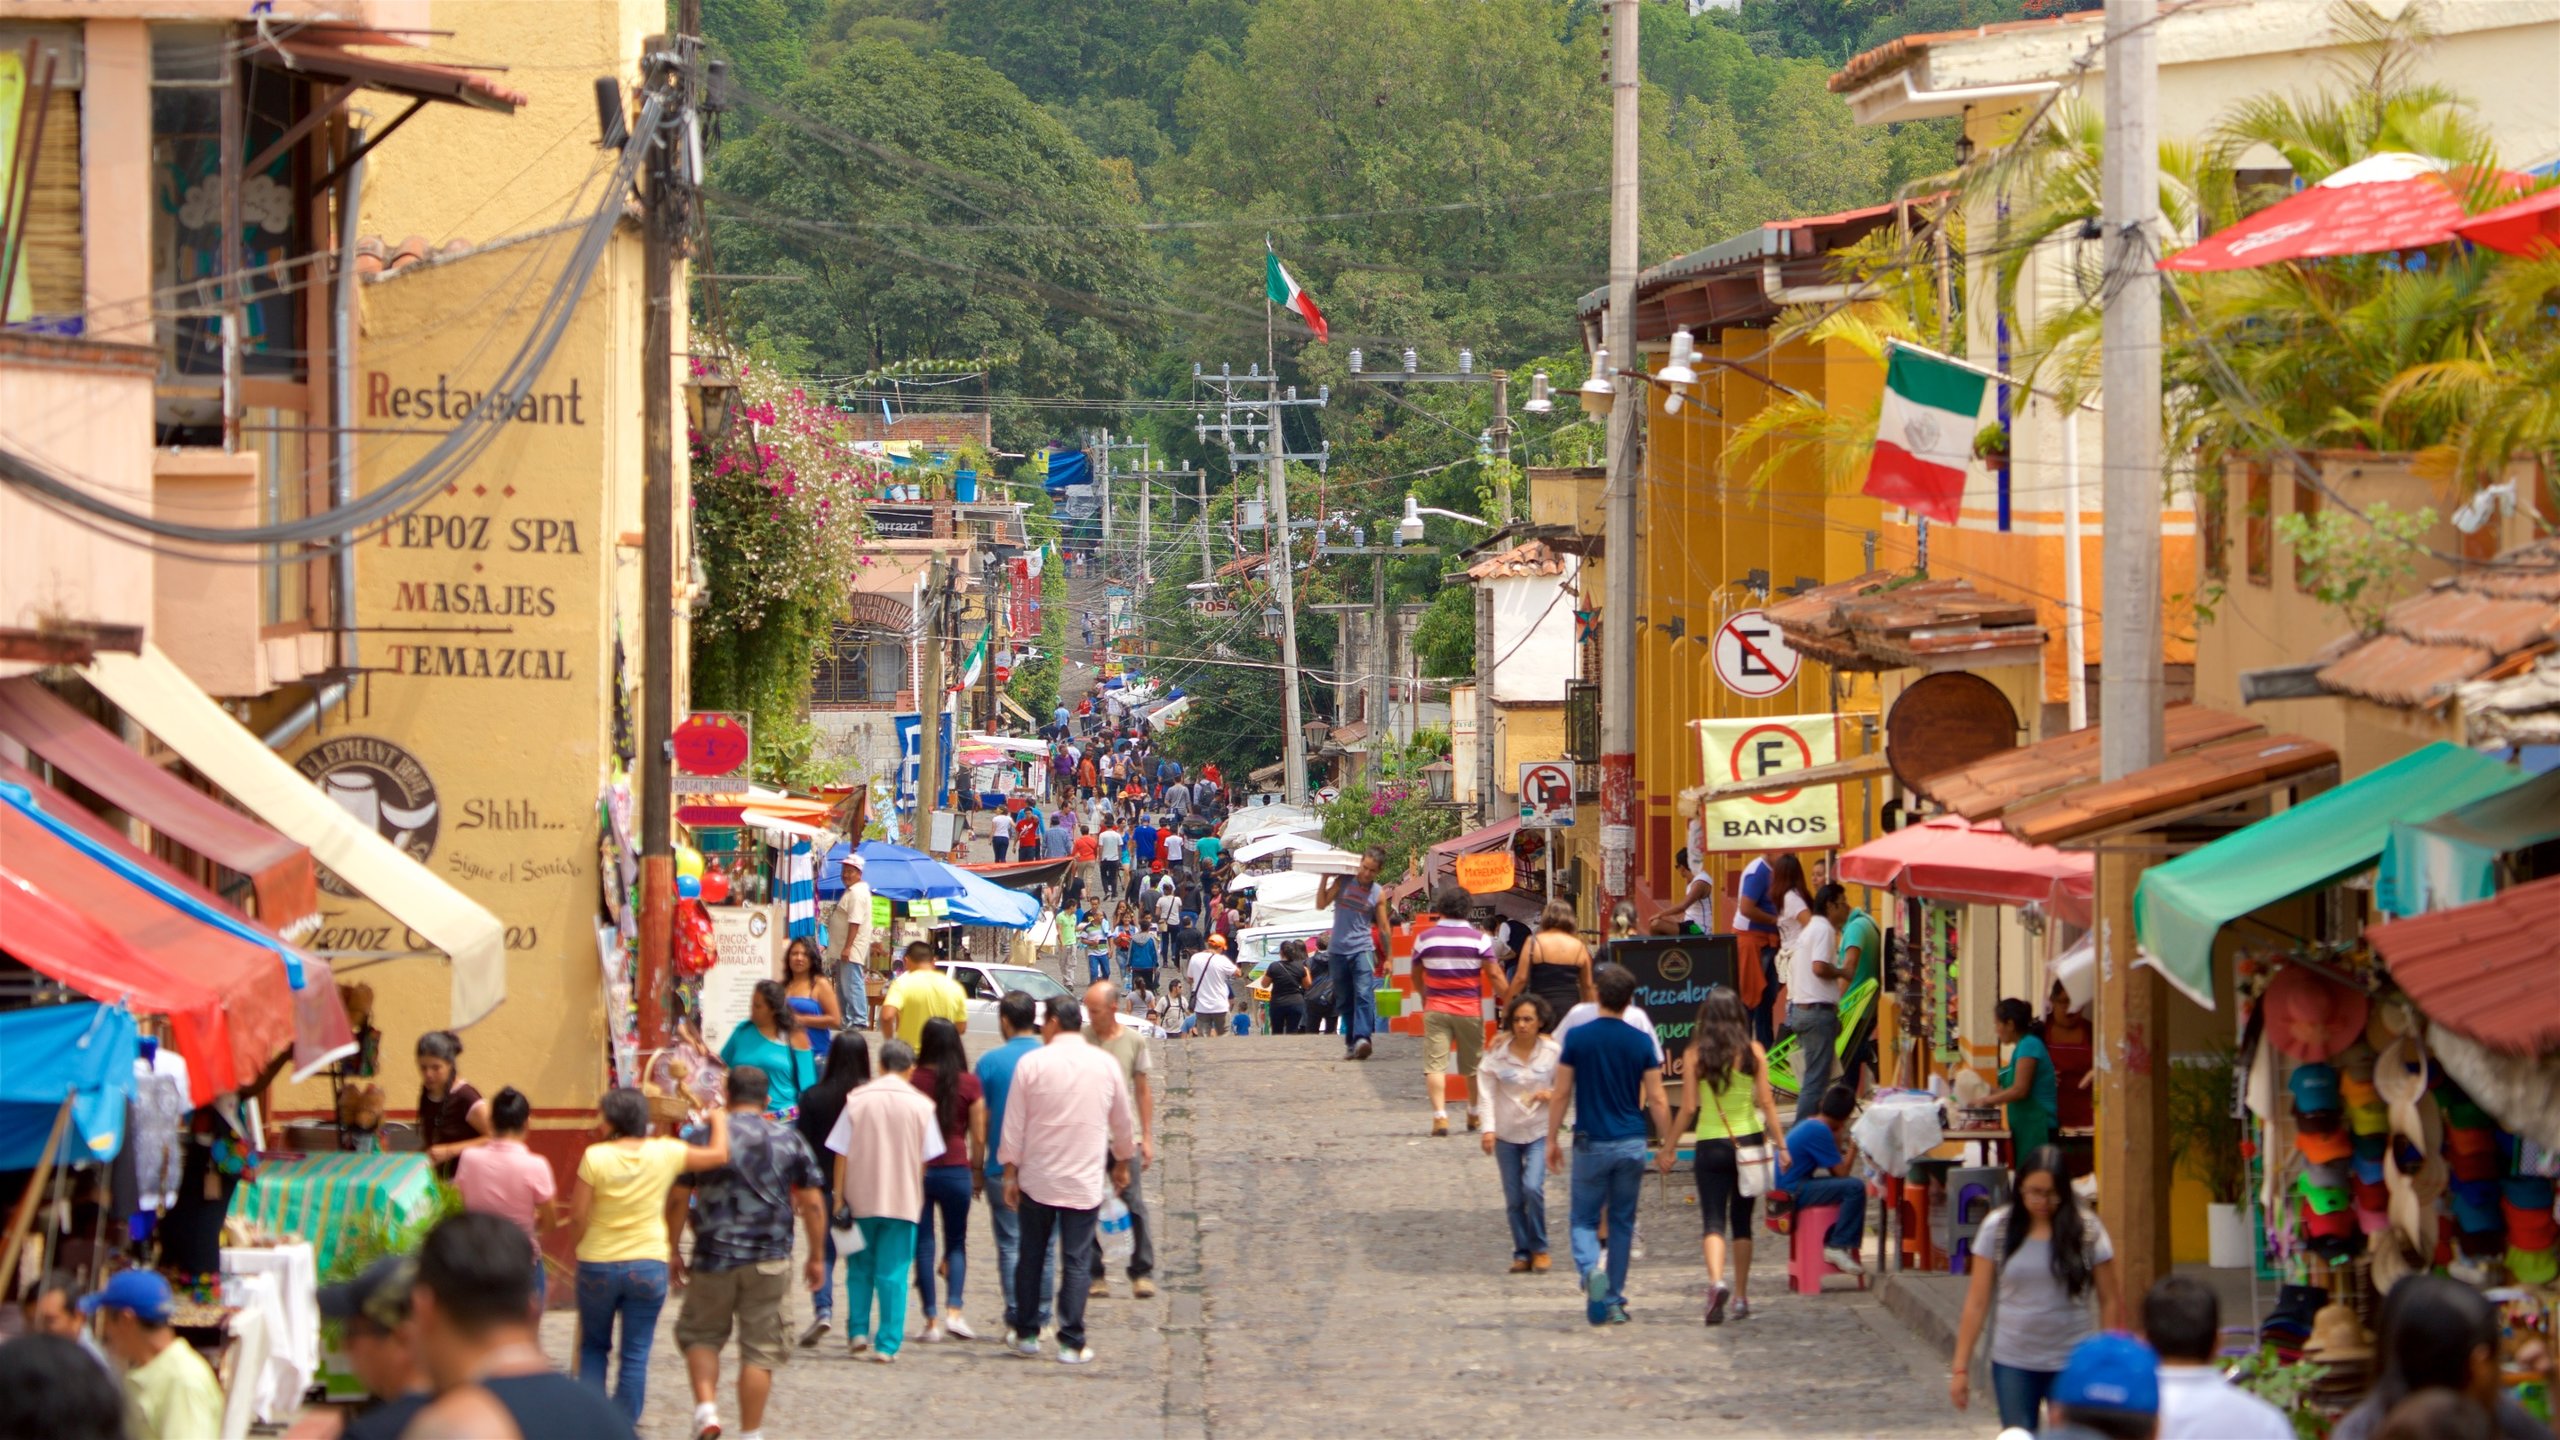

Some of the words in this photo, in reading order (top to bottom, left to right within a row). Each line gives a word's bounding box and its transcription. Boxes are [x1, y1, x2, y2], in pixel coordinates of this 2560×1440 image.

[367, 371, 584, 425] Restaurant
[368, 512, 491, 551] TEPOZ
[508, 518, 581, 554] SPA
[392, 581, 556, 617] MASAJES
[386, 644, 573, 680] TEMAZCAL
[300, 739, 398, 778] ELEPHANT
[455, 799, 564, 832] Shhh...
[1723, 814, 1827, 837] BAÑOS
[449, 852, 494, 880] Sigue
[499, 862, 514, 883] el
[1631, 979, 1718, 1006] Mezcaler
